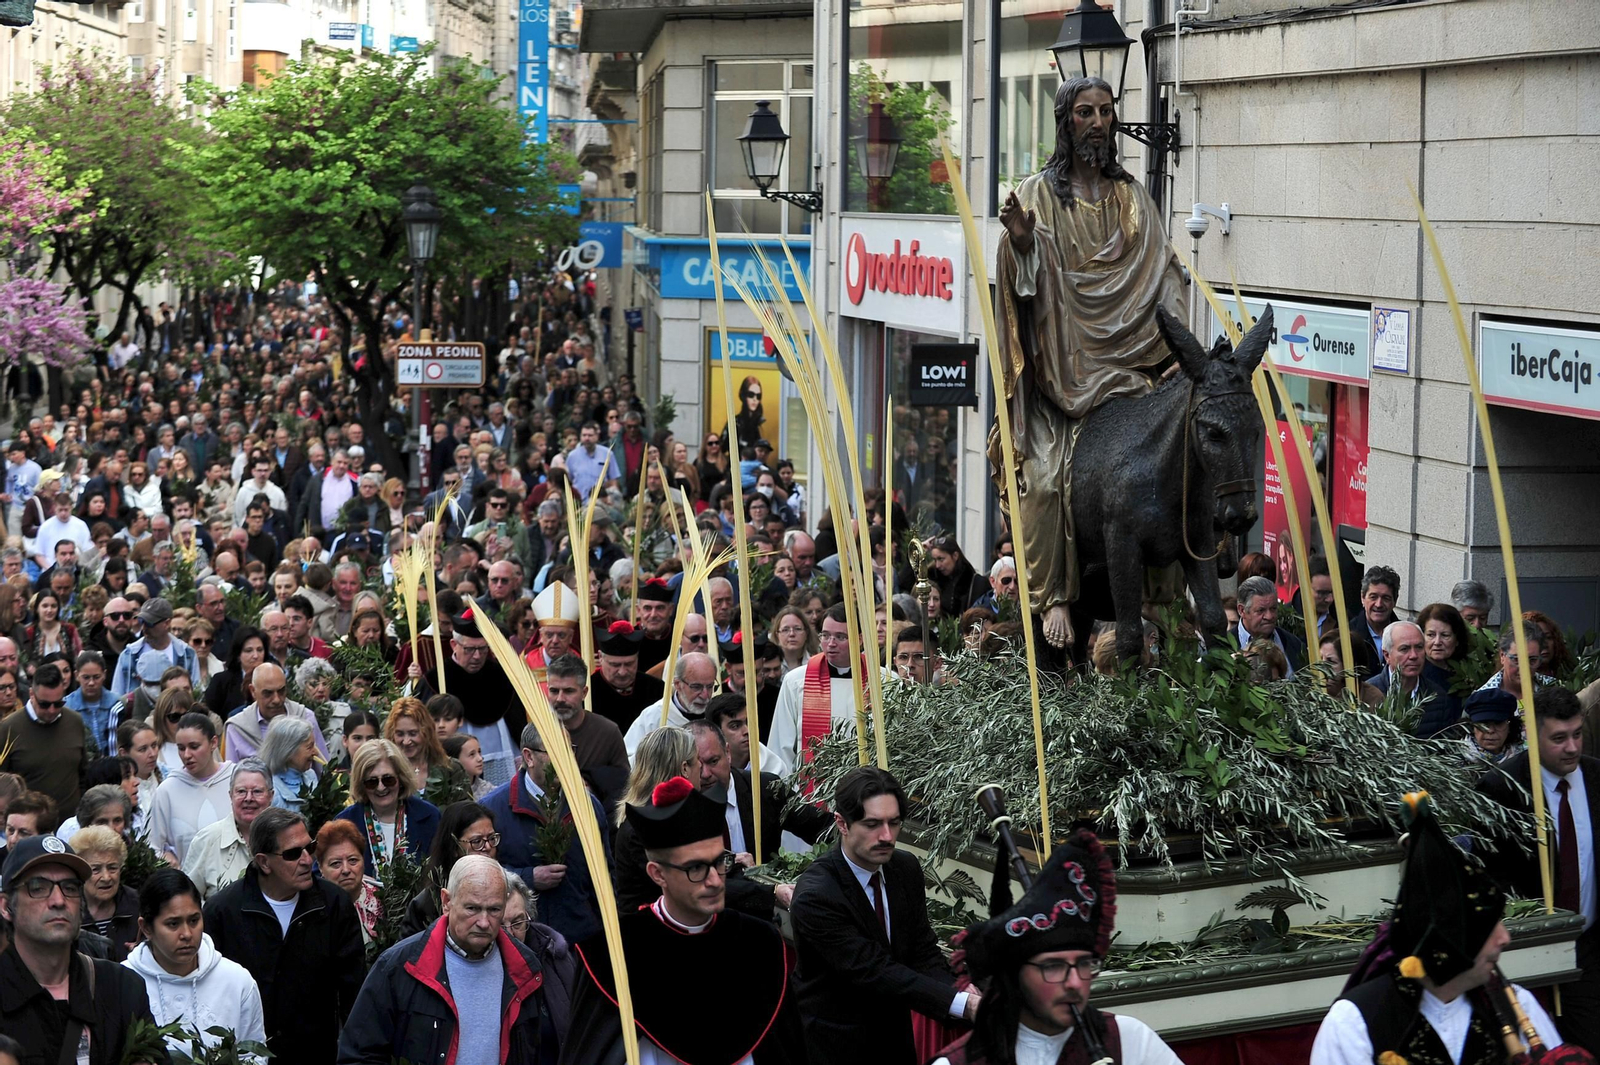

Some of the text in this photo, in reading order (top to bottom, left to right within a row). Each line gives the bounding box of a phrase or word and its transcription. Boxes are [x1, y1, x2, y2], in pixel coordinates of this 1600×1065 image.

[520, 9, 548, 23] LOS
[866, 239, 954, 301] vodafone
[398, 346, 481, 358] ZONA PEONIL
[1313, 332, 1356, 356] Ourense
[1511, 342, 1592, 394] iberCaja
